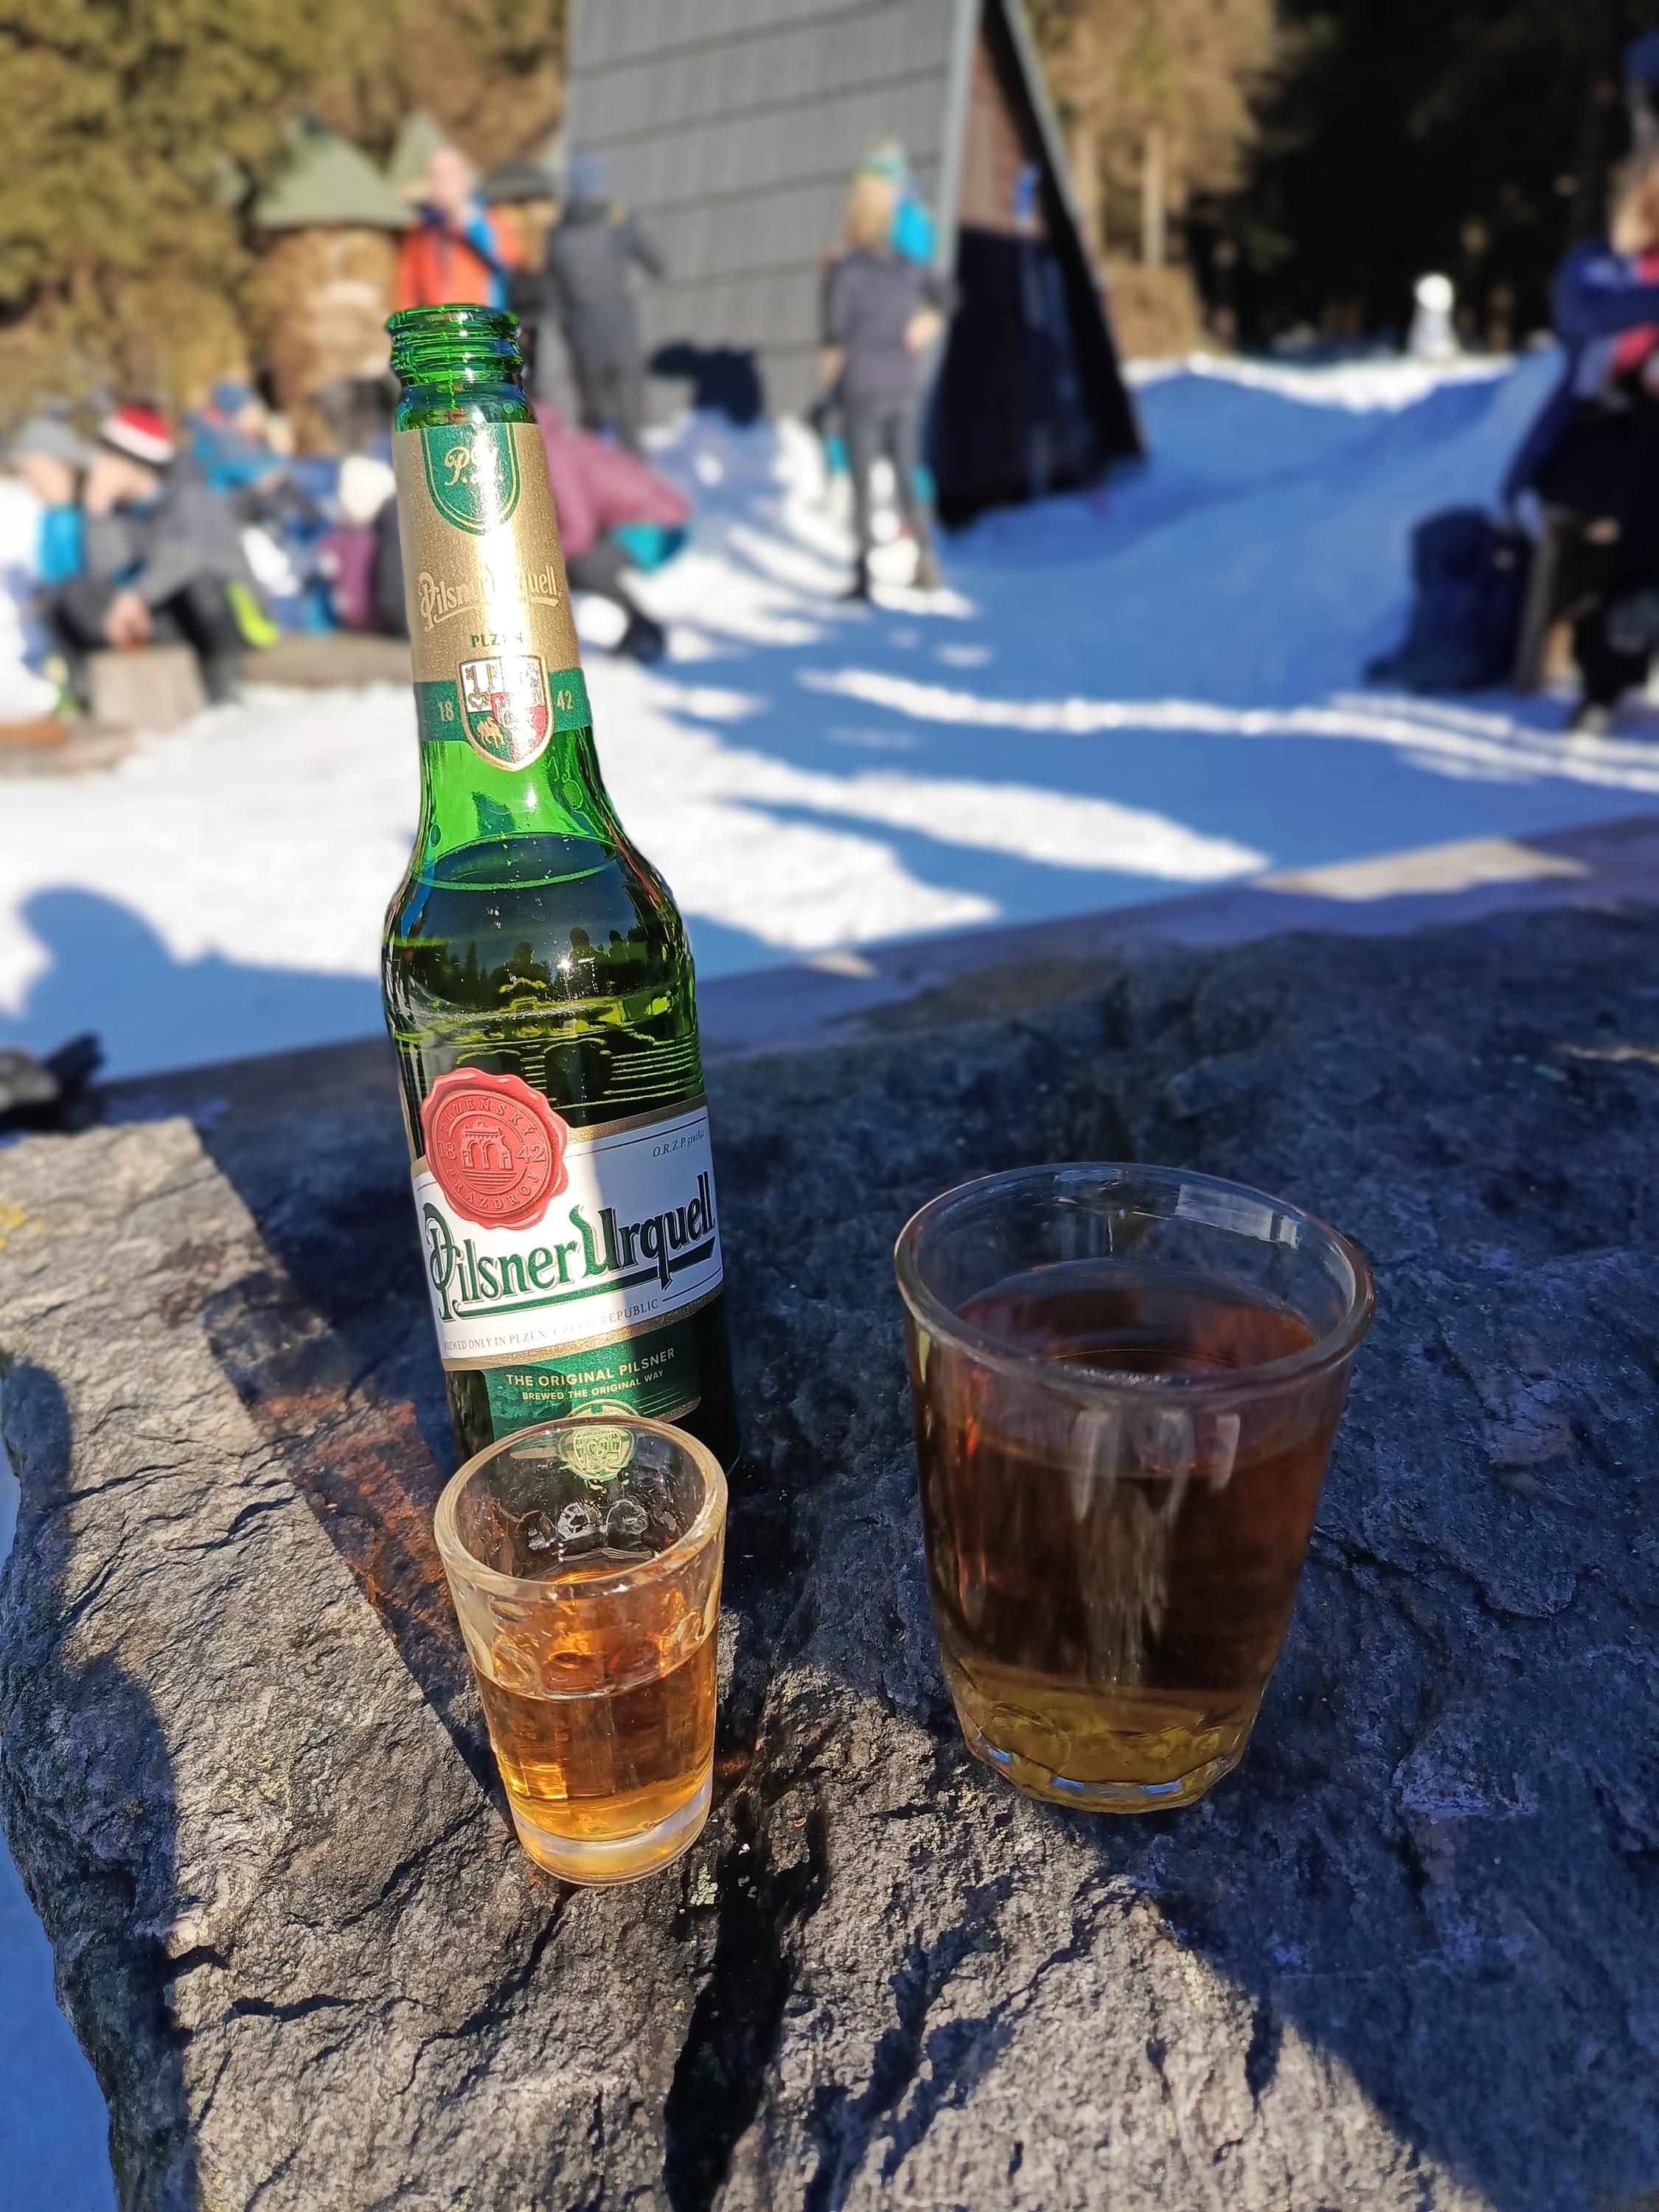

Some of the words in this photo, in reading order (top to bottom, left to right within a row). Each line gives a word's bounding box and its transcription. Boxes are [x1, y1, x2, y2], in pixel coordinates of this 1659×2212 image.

[418, 571, 487, 633] Pilsn
[470, 632, 524, 648] PLZ
[437, 700, 455, 723] 18
[557, 689, 574, 712] 42
[438, 1139, 456, 1161] 18
[516, 1143, 547, 1164] 42
[446, 1168, 539, 1210] PRAZDROJ
[422, 1203, 581, 1323] Pilsner
[568, 1171, 716, 1291] Urquell
[468, 1338, 492, 1349] ONLY
[495, 1335, 506, 1346] IN
[600, 1298, 659, 1325] REPUBLIC
[506, 1374, 534, 1387] THE
[538, 1368, 614, 1387] ORIGINAL
[619, 1348, 675, 1377] PILSNER
[522, 1391, 564, 1400] BREWED
[568, 1389, 588, 1399] THE
[591, 1378, 642, 1396] ORIGINAL
[644, 1369, 664, 1382] WAY
